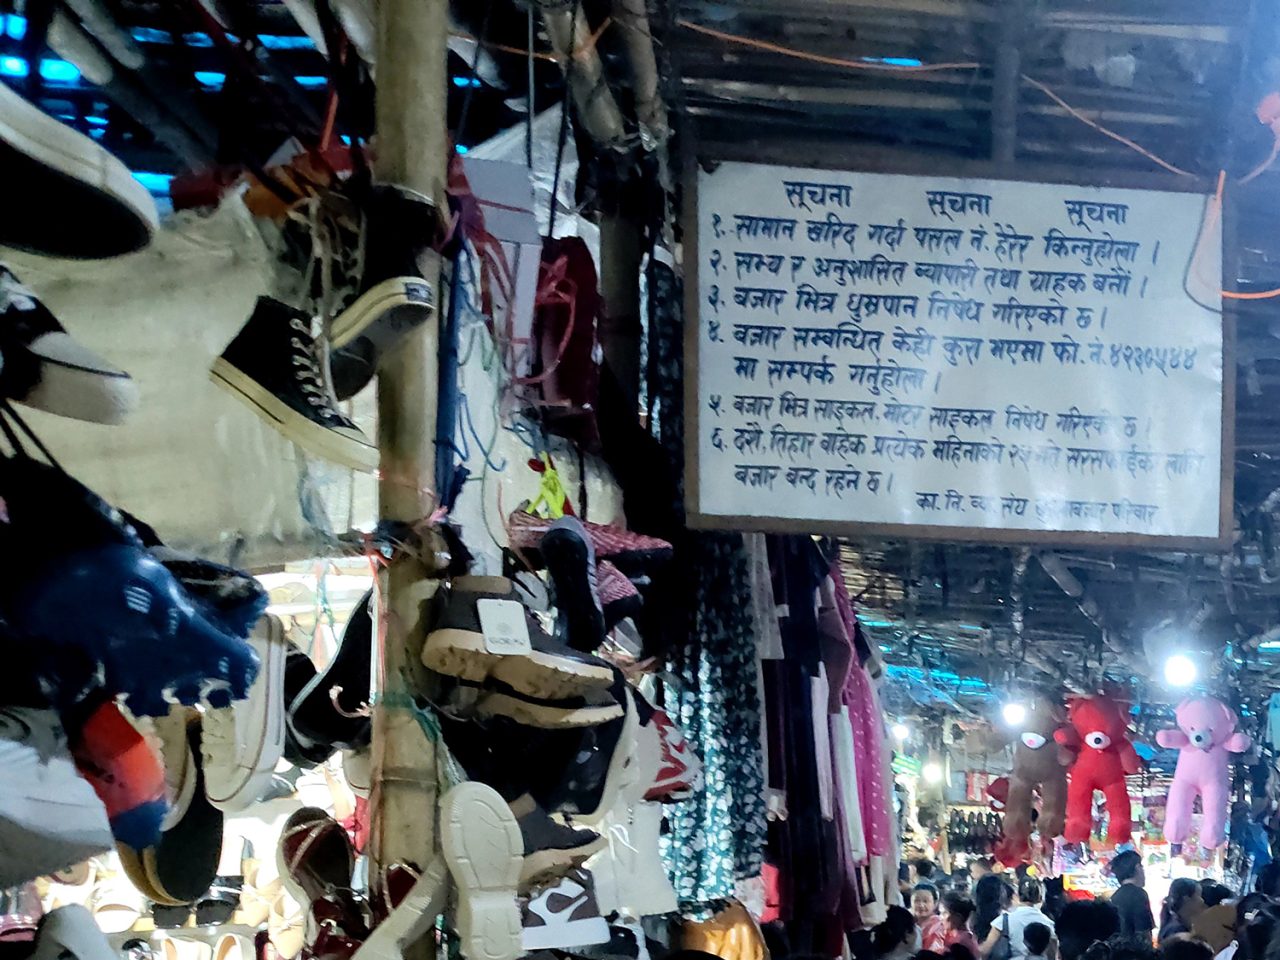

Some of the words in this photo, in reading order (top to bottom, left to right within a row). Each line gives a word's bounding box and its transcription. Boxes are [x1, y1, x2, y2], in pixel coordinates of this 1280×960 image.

[781, 180, 853, 213] सूचना
[925, 190, 993, 222] सूचना
[1064, 200, 1130, 233] सूचना
[733, 214, 800, 241] सामान
[805, 211, 859, 252] खरिद
[868, 218, 908, 252] गर्दा
[913, 227, 964, 256] पसल
[993, 222, 1034, 264] हेरेर
[1041, 227, 1141, 267] किन्नुहोला
[733, 251, 785, 280] सभ्य
[790, 255, 807, 283] र
[813, 253, 909, 287] अनुशासित
[915, 257, 980, 292] व्यापारी
[983, 267, 1023, 295] तथा
[1028, 269, 1087, 298] ग्राहक
[733, 286, 788, 315] बजार
[795, 283, 839, 314] भित्र
[927, 290, 985, 323] निषेध
[992, 297, 1069, 332] गरिएको
[1075, 306, 1094, 329] छ
[732, 323, 786, 351] बजार
[792, 321, 885, 358] सम्बन्धित
[892, 326, 937, 361] केही
[942, 336, 984, 366] कुरा
[989, 338, 1046, 365] भएमा
[733, 356, 759, 381] मा
[768, 355, 837, 388] सम्पर्क
[848, 358, 928, 395] गर्नुहोला
[732, 395, 774, 420] बजार
[779, 390, 810, 418] भित्र
[883, 397, 926, 428] मोटर
[929, 406, 997, 434] साइकल
[1005, 404, 1050, 432] निषेध
[1122, 415, 1138, 438] छ
[770, 423, 817, 459] तिहार
[820, 426, 868, 460] बाहेक
[872, 430, 928, 462] प्रत्येक
[932, 434, 1005, 468] महिनाको
[734, 464, 783, 491] बजार
[785, 466, 819, 496] बन्द
[825, 464, 860, 499] रहने
[866, 471, 882, 495] छ
